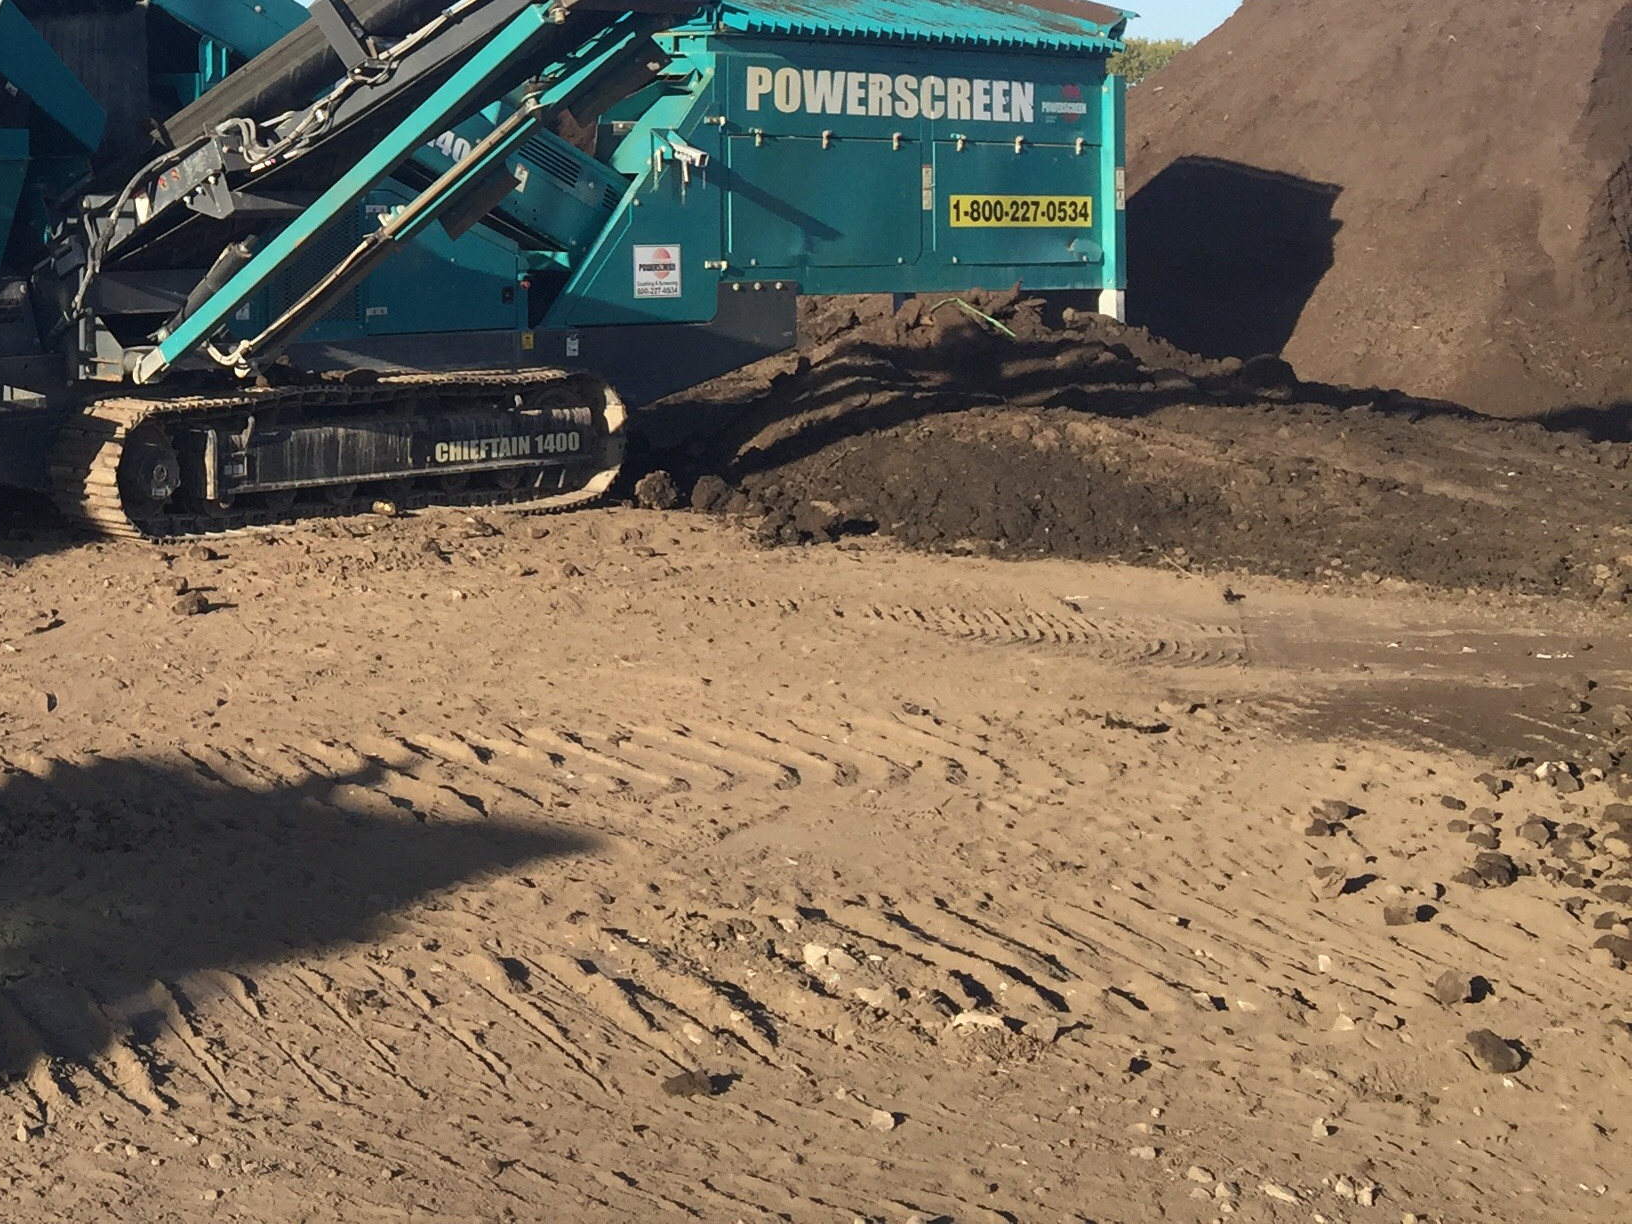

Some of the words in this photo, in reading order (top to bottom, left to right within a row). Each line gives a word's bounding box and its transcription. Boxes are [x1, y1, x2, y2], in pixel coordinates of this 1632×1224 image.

[746, 65, 1034, 122] POWERSCREEN
[953, 199, 1089, 222] 1-800-227-0534
[435, 435, 531, 463] CHIEFTAIN
[534, 431, 580, 454] 1400
